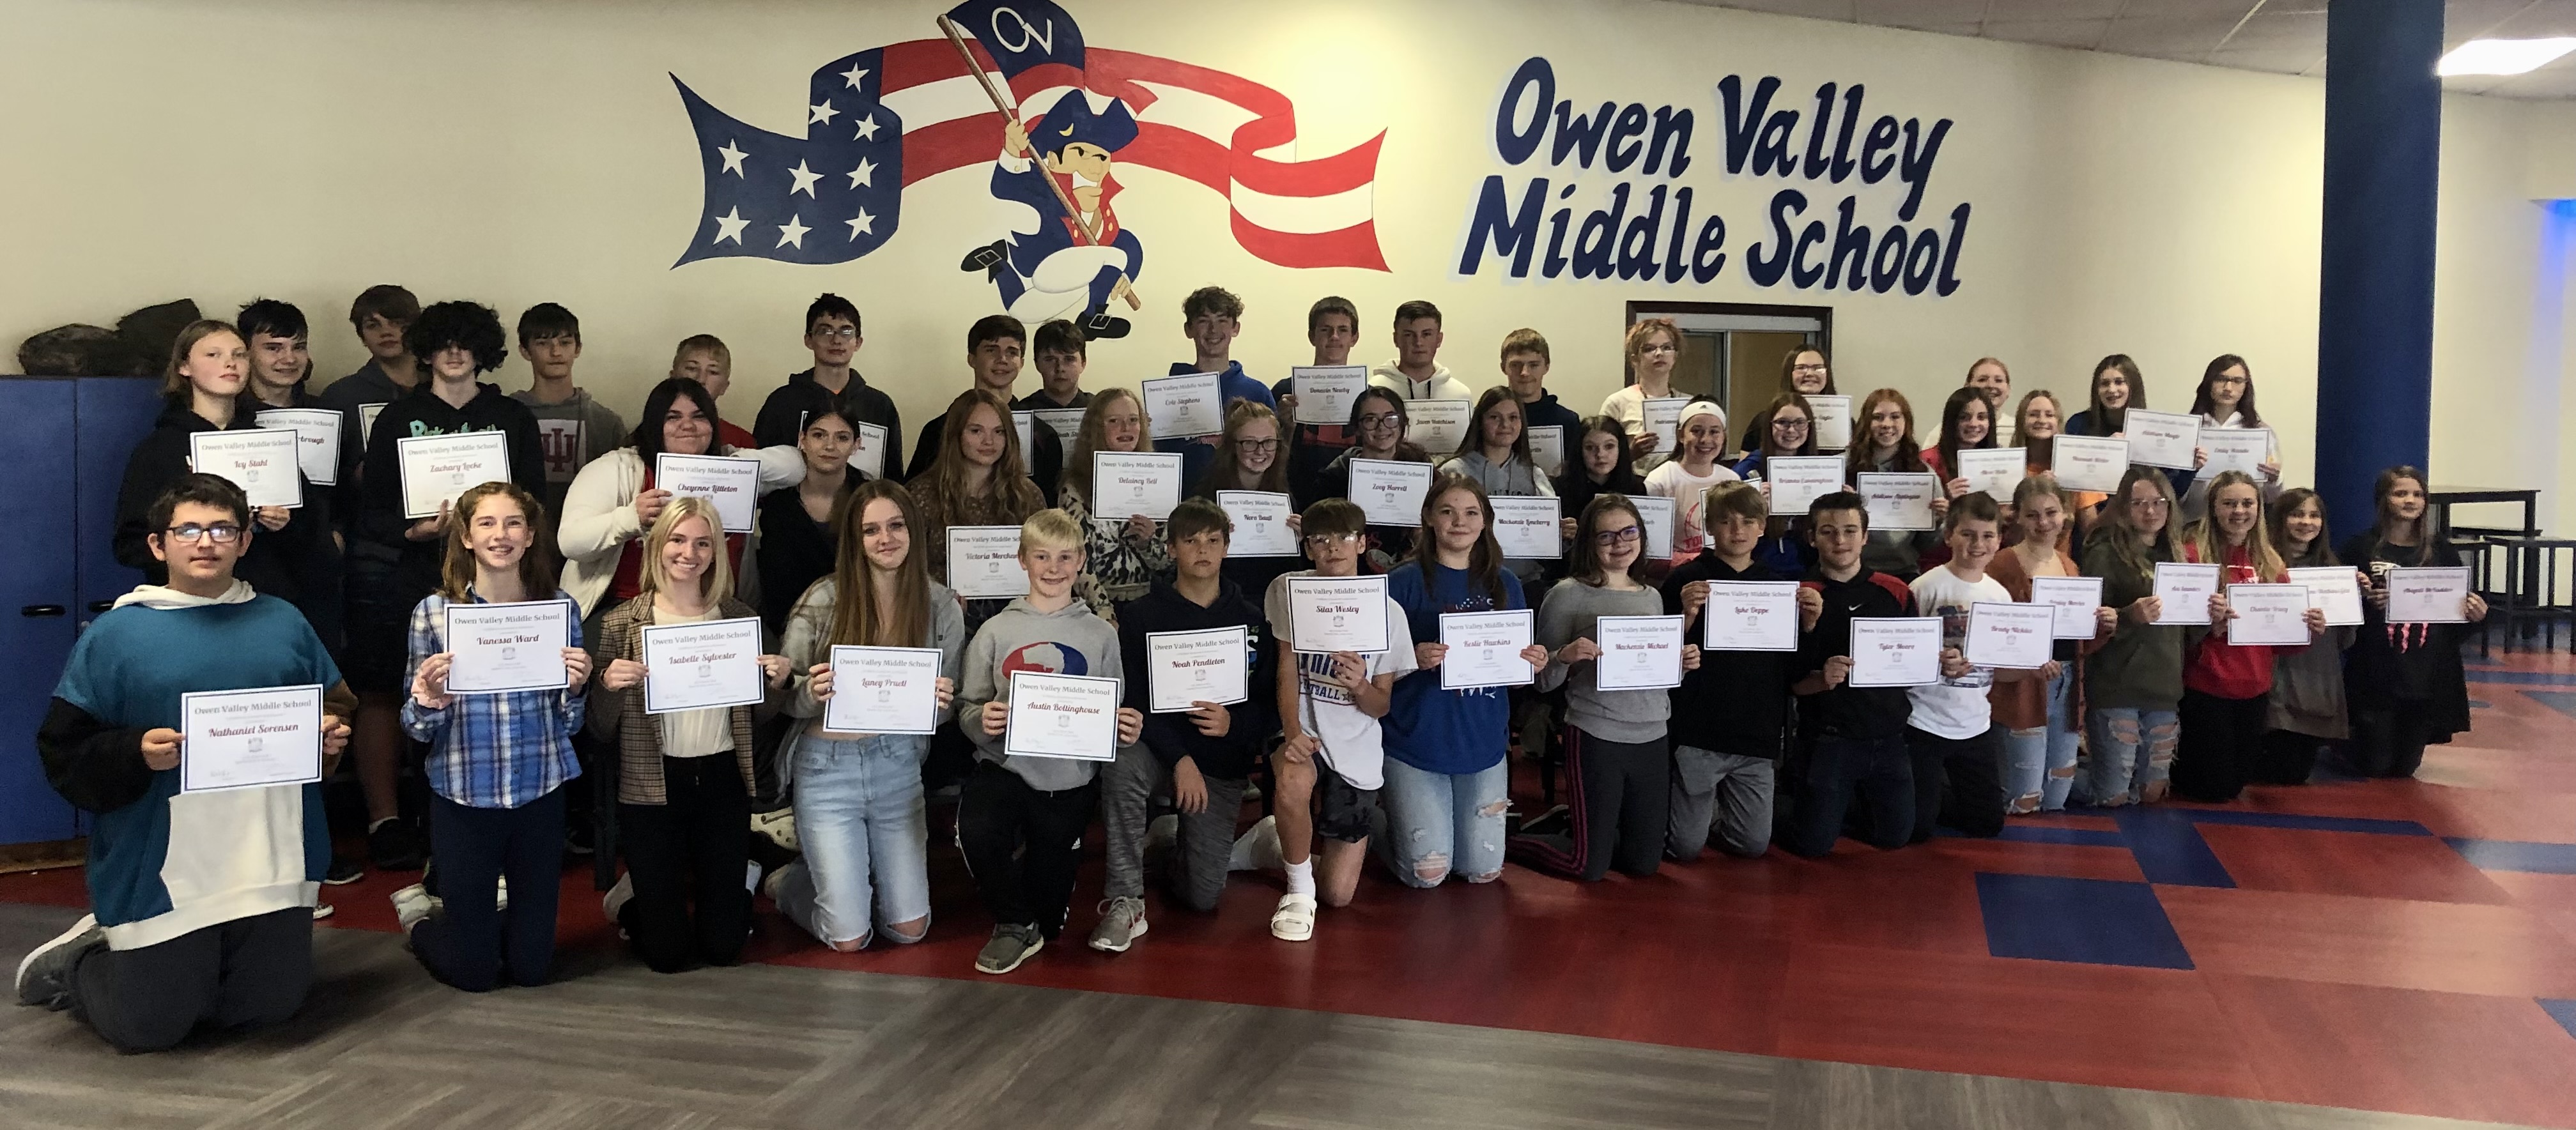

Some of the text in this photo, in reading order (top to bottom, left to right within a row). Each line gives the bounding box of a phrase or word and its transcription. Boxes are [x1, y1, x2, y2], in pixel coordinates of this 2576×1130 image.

[1496, 56, 1954, 221] Owen Valley
[1458, 175, 1971, 296] Middle School
[430, 464, 460, 473] Zachary
[1334, 606, 1359, 614] Wesley
[514, 634, 539, 643] Ward
[727, 630, 751, 639] School
[669, 653, 737, 664] Isabelle Sylvester
[1192, 659, 1225, 667] Pendleton
[861, 659, 882, 668] Valley
[1040, 685, 1061, 693] Valley
[222, 704, 249, 714] Valley
[251, 701, 282, 710] Middle
[283, 699, 311, 708] School
[1028, 701, 1051, 711] Austin
[209, 724, 298, 737] Nathaniel Sorensen
